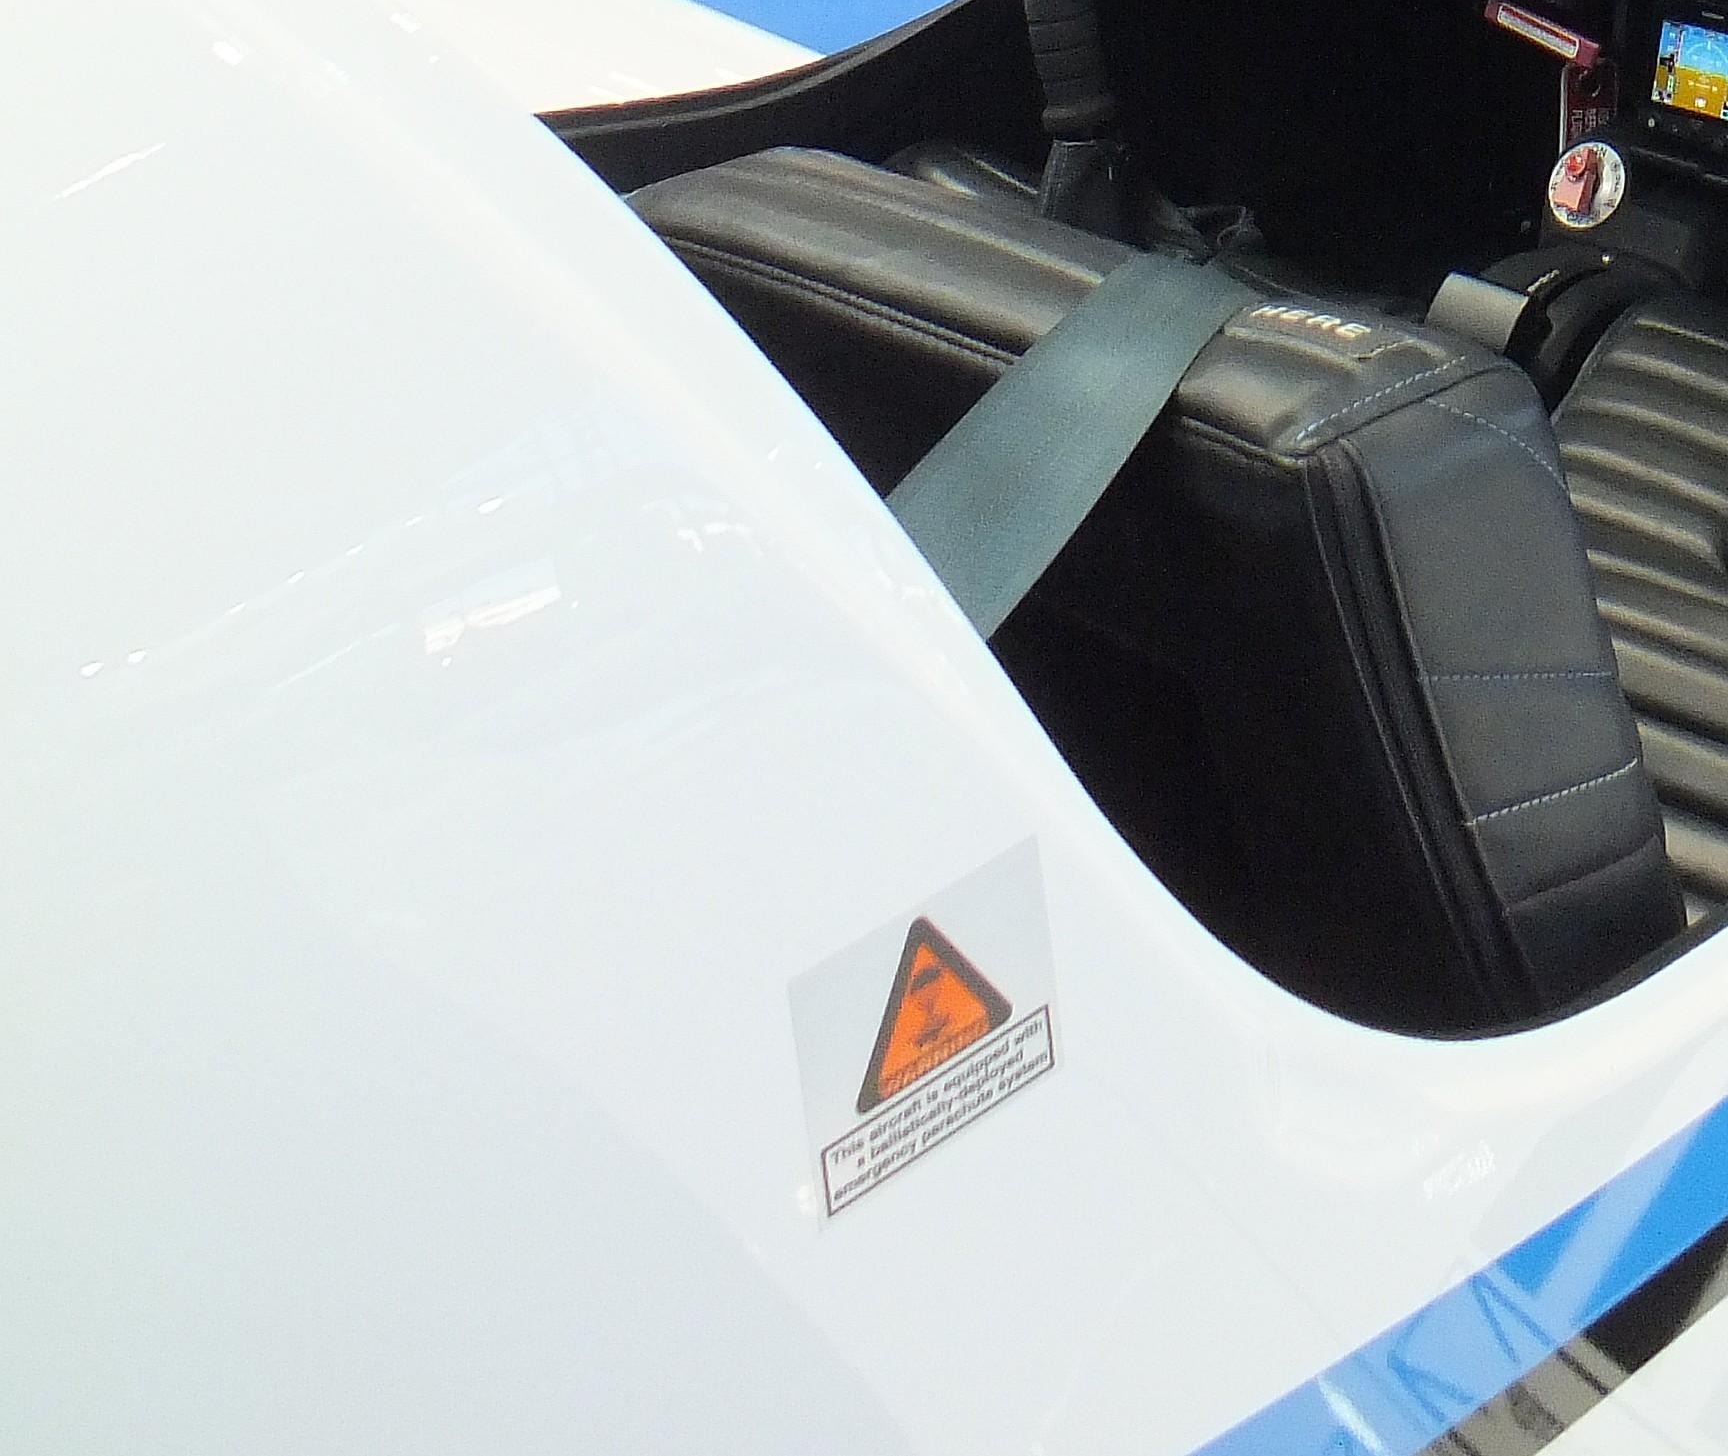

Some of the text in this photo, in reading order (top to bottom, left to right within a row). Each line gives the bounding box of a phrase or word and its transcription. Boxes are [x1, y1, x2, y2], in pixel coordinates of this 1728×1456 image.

[831, 1139, 865, 1165] This
[869, 1097, 923, 1140] aircraft
[943, 1043, 1012, 1092] equipped
[1014, 1018, 1044, 1045] with
[833, 1140, 918, 1202] emergency
[921, 1087, 994, 1145] parachute
[997, 1051, 1050, 1091] system
